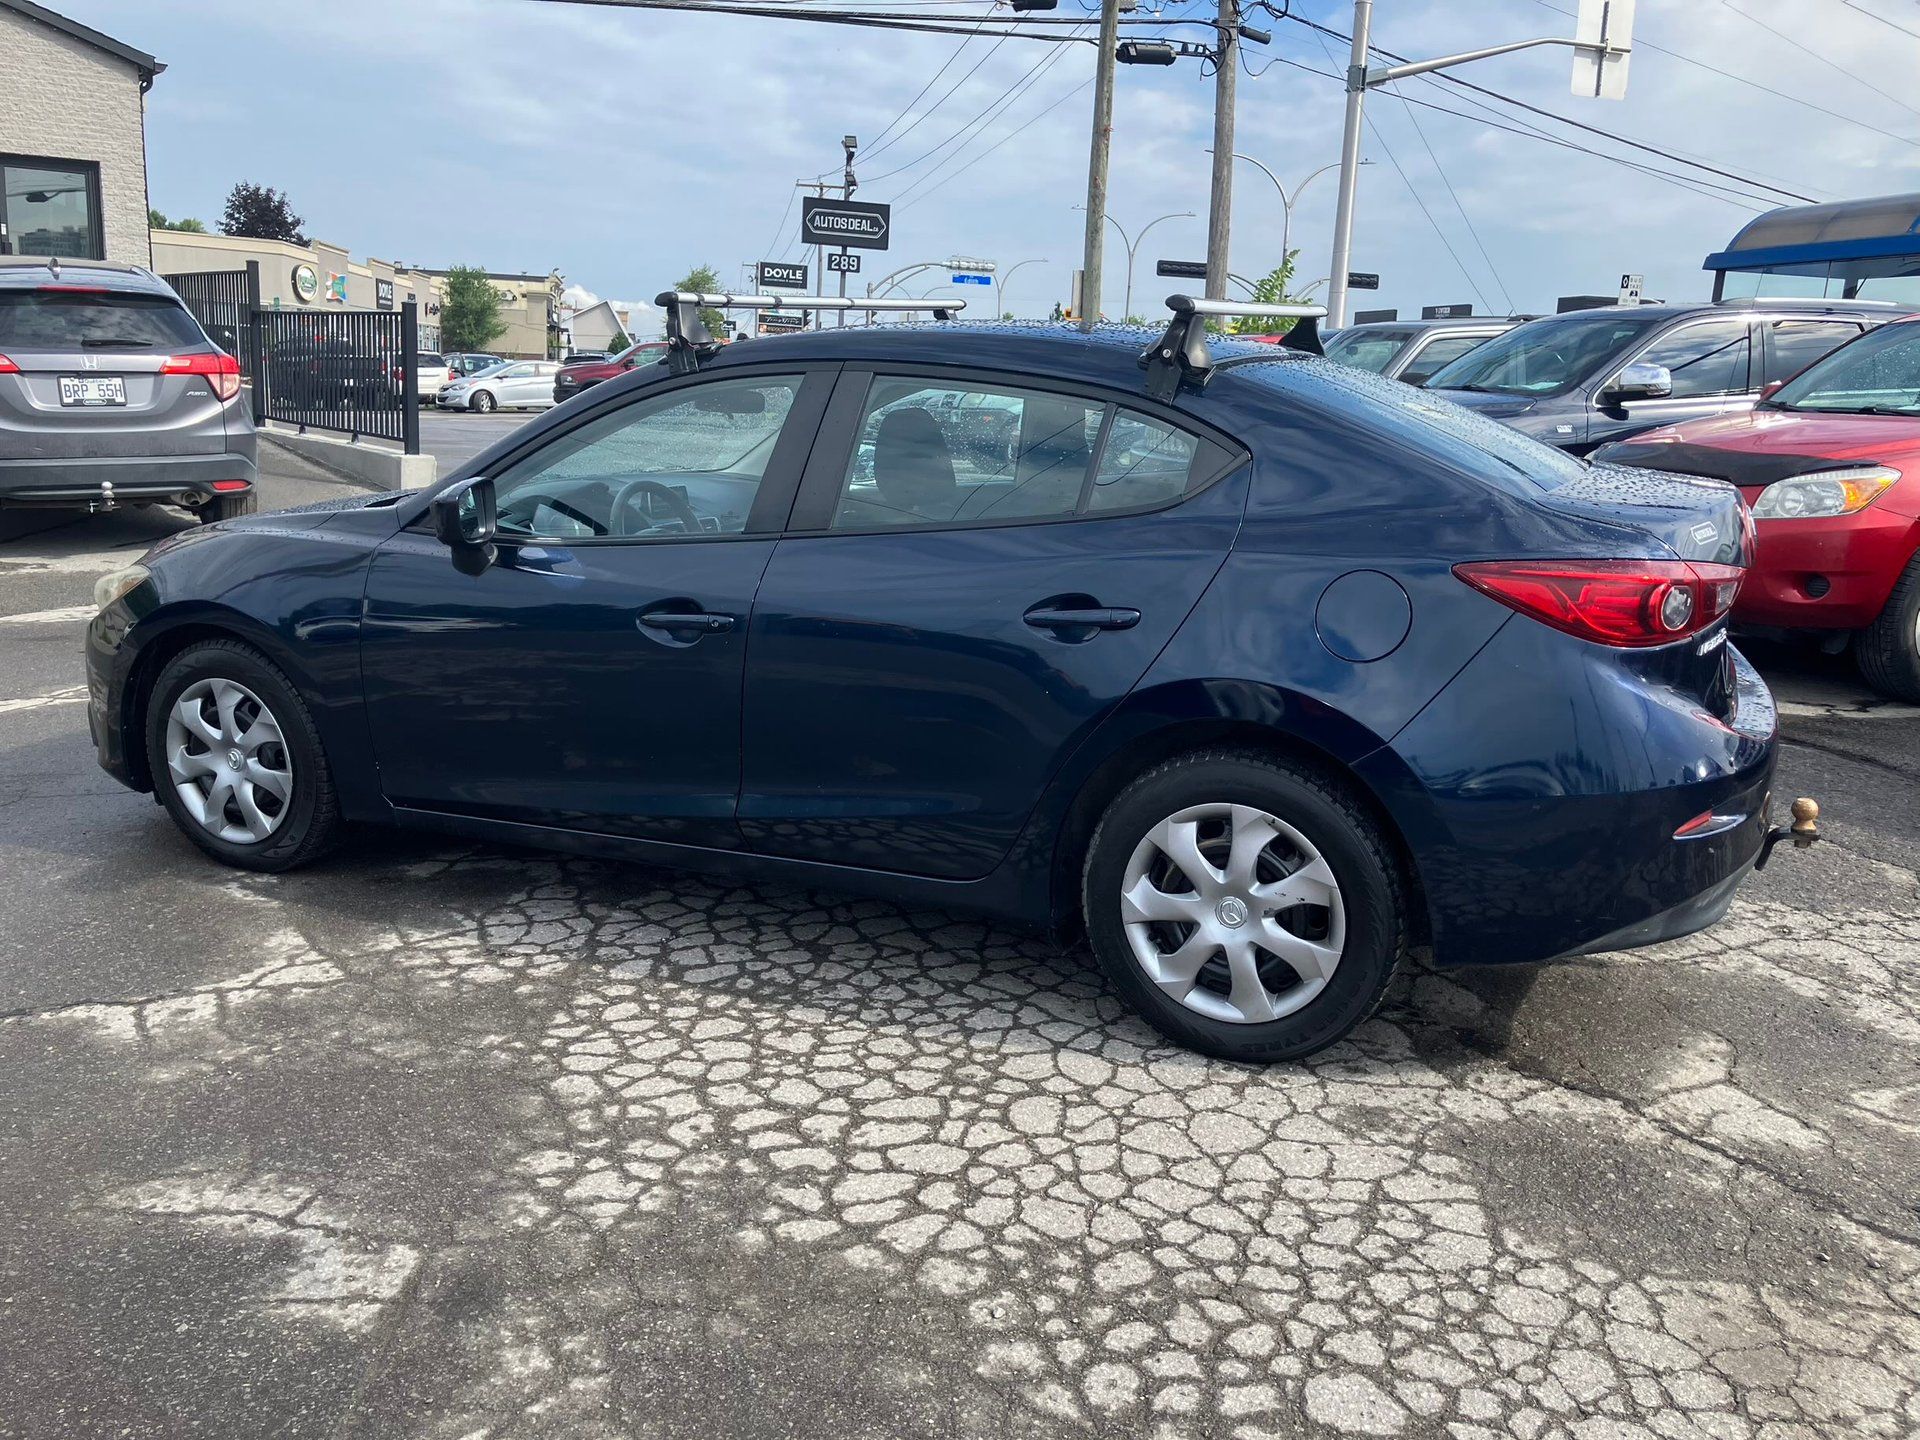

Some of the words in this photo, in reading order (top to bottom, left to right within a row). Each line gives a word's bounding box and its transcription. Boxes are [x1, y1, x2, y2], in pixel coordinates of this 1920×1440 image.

[831, 255, 858, 271] 289
[764, 267, 803, 280] DOYLE
[63, 383, 89, 398] BRP
[97, 383, 123, 398] 55H
